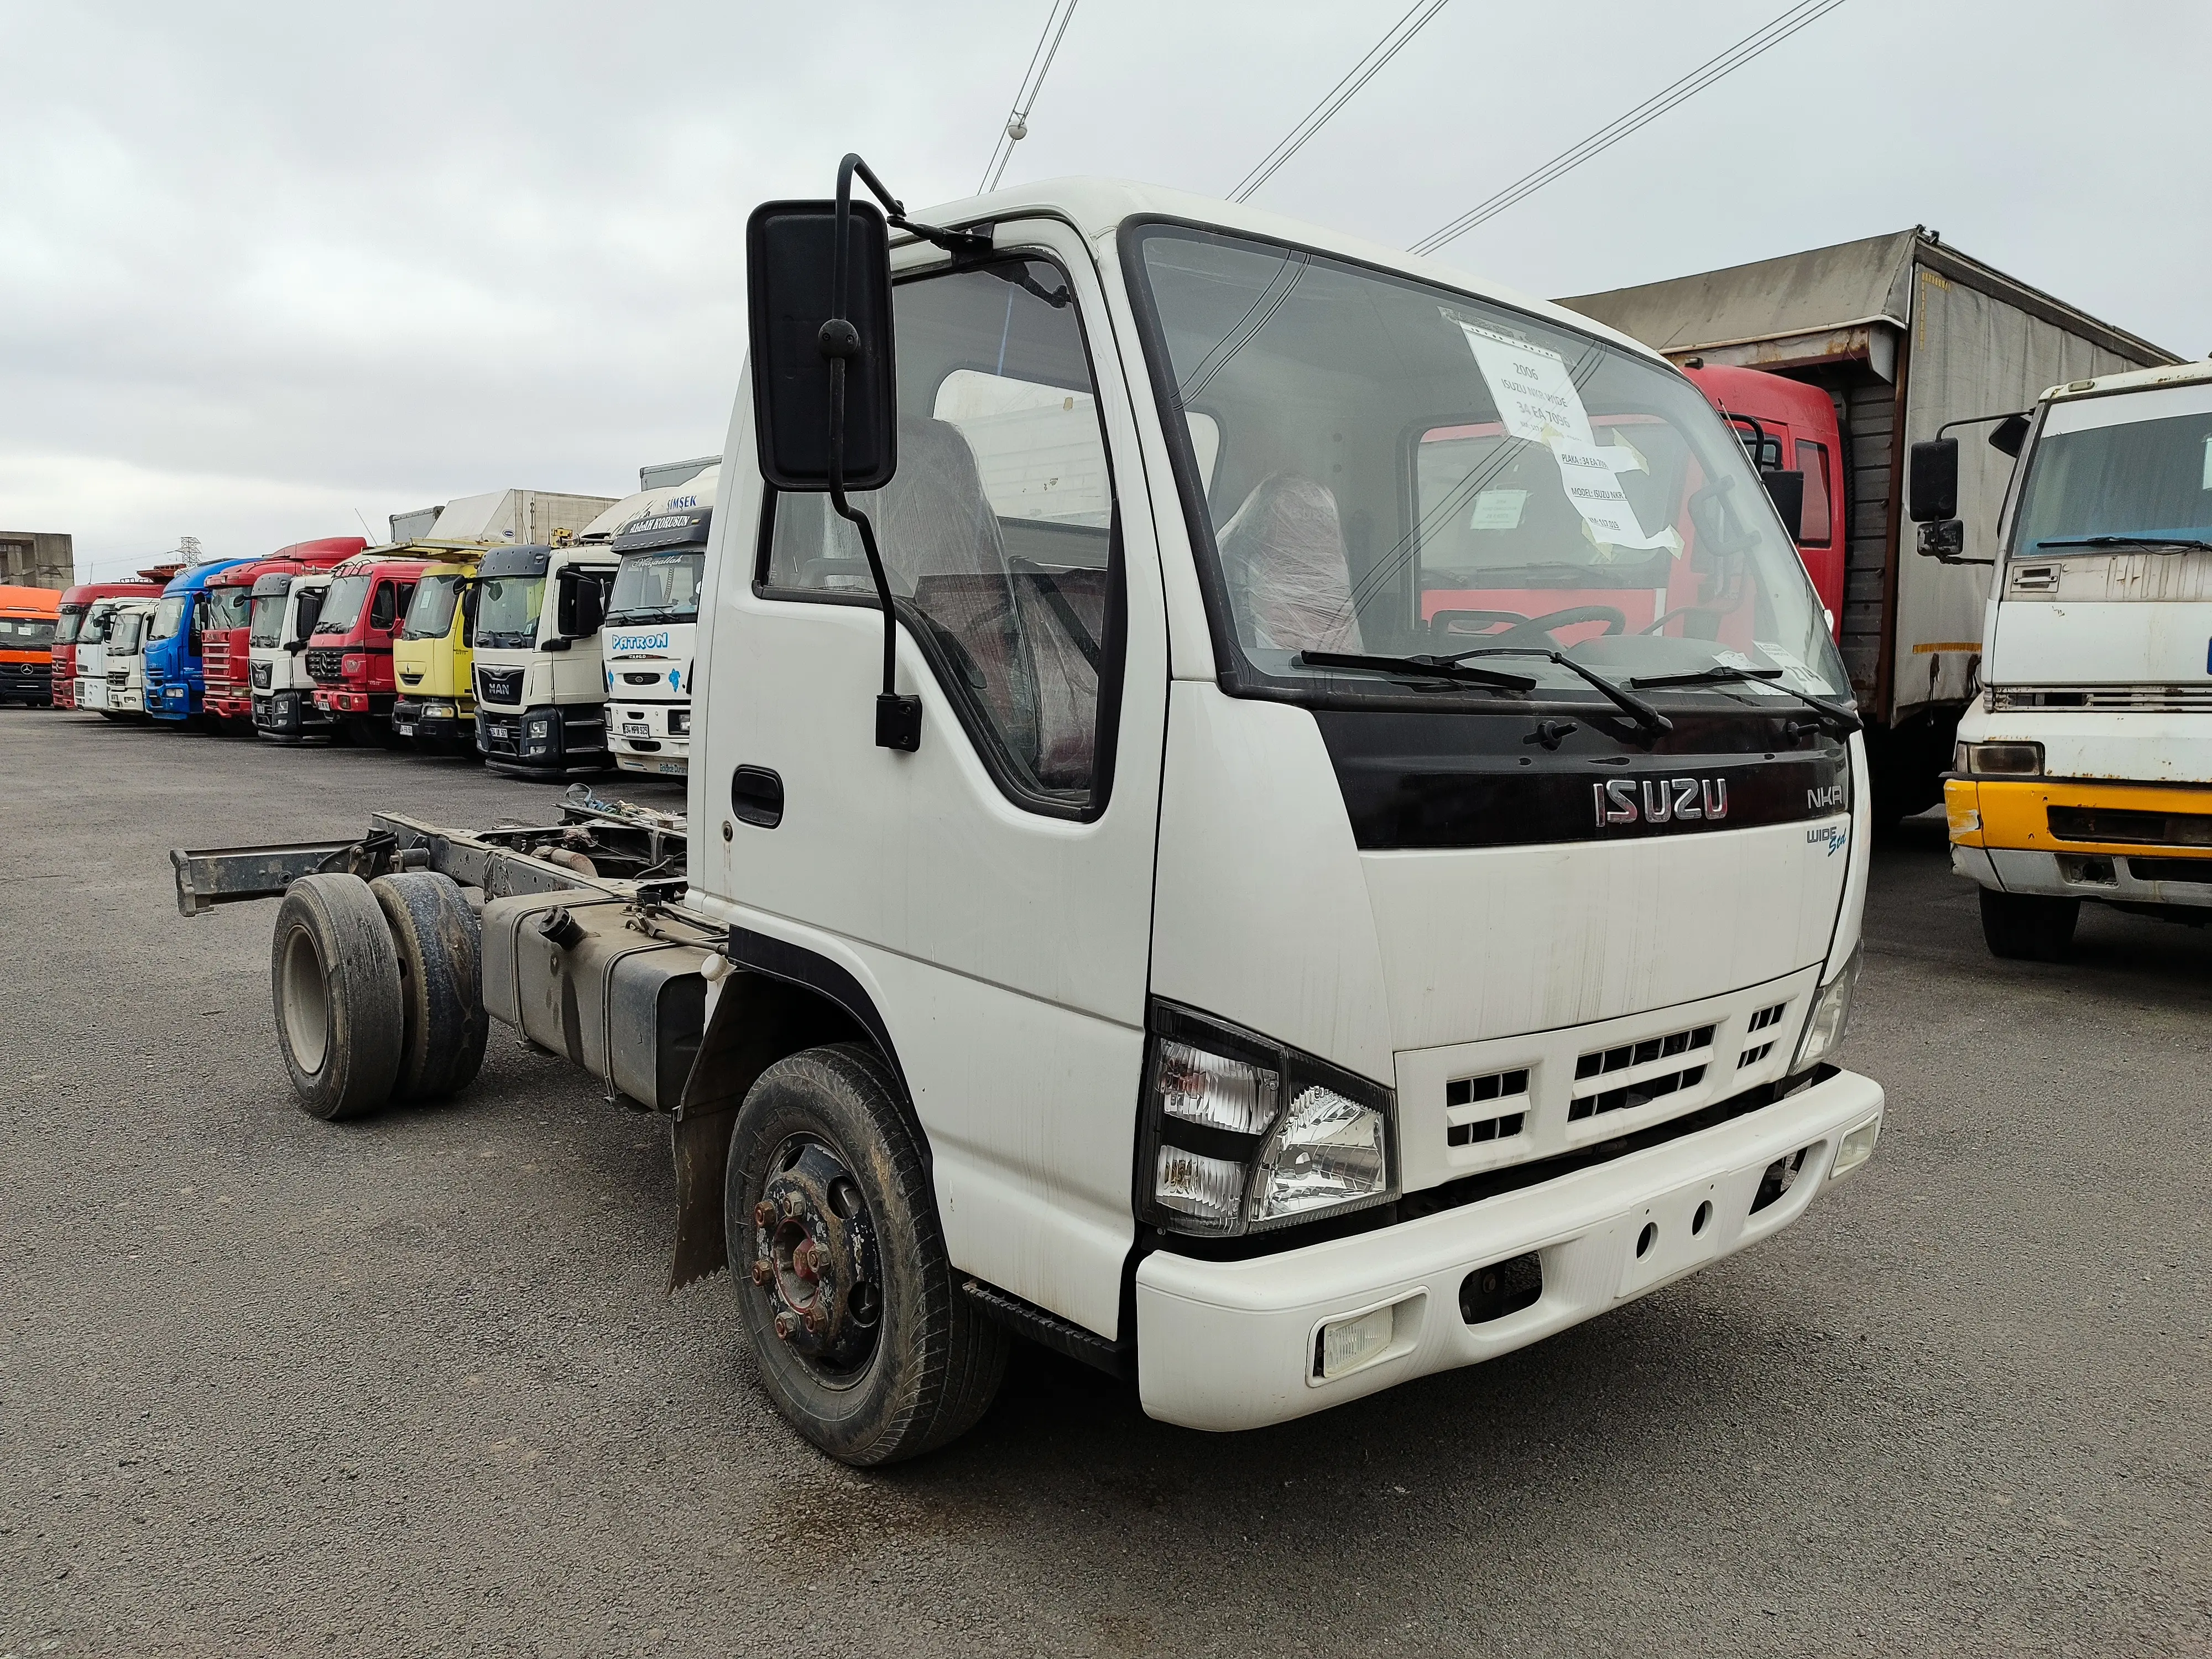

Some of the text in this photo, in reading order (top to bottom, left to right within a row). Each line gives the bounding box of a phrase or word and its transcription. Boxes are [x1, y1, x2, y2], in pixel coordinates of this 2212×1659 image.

[1513, 363, 1538, 380] 2006
[1501, 378, 1568, 408] ISUZU NKR WIDE
[1516, 401, 1571, 428] 34 EA 7096
[1562, 454, 1579, 465] PLAKA
[1582, 457, 1589, 465] 34
[1571, 487, 1593, 497] MODEL:
[1594, 489, 1610, 498] ISUZU
[629, 515, 690, 534] ALLAH KORUSUN
[612, 632, 668, 650] PATRON
[489, 683, 509, 695] MAN
[1592, 778, 1728, 827] ISUZU
[1807, 826, 1846, 857] WIDE Std
